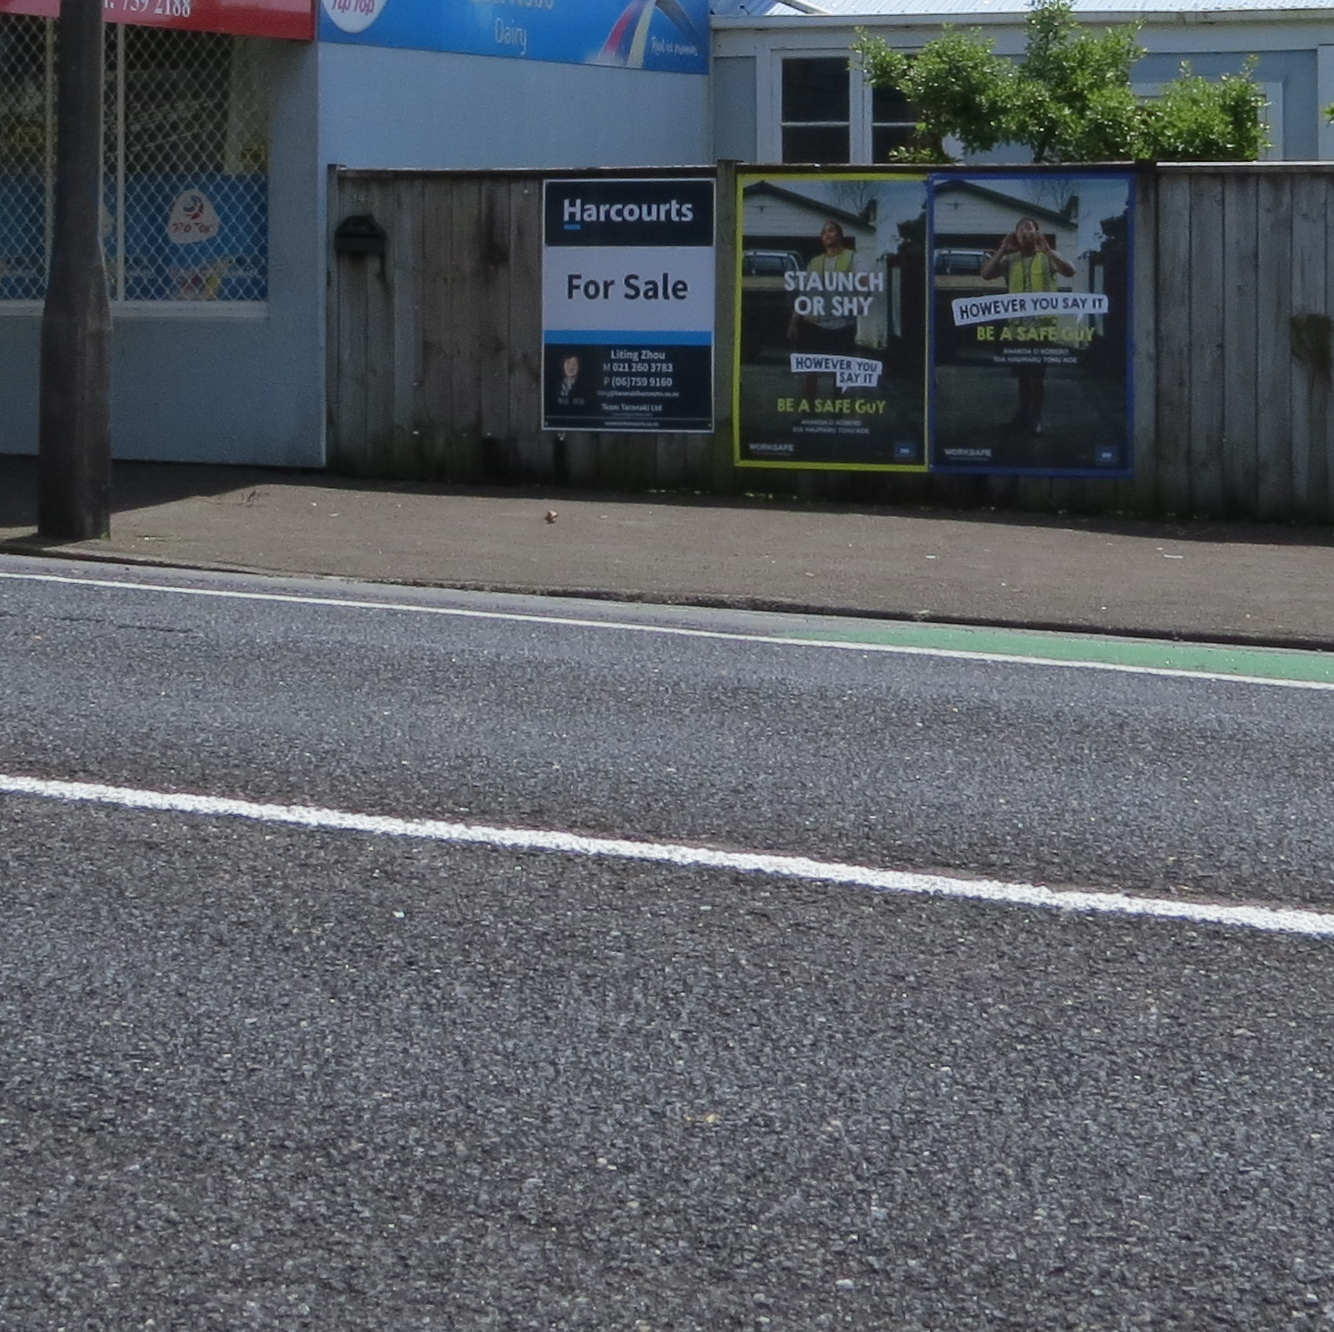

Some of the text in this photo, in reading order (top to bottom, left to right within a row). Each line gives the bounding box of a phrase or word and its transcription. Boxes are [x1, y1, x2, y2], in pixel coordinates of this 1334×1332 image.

[494, 18, 528, 56] Dairy
[563, 198, 694, 222] Harcourts
[567, 272, 688, 300] For Sale
[784, 271, 884, 292] STAUNCH
[794, 296, 873, 317] OR SHY
[959, 297, 1103, 320] HOWEVER YOU SAY IT
[977, 326, 1095, 341] BE A SAFE GUY
[641, 349, 666, 360] Zhou
[795, 357, 877, 373] HOWEVER YOU
[839, 373, 873, 384] SAY IT
[777, 398, 794, 412] BE
[798, 399, 810, 412] A
[814, 399, 851, 413] SAFE
